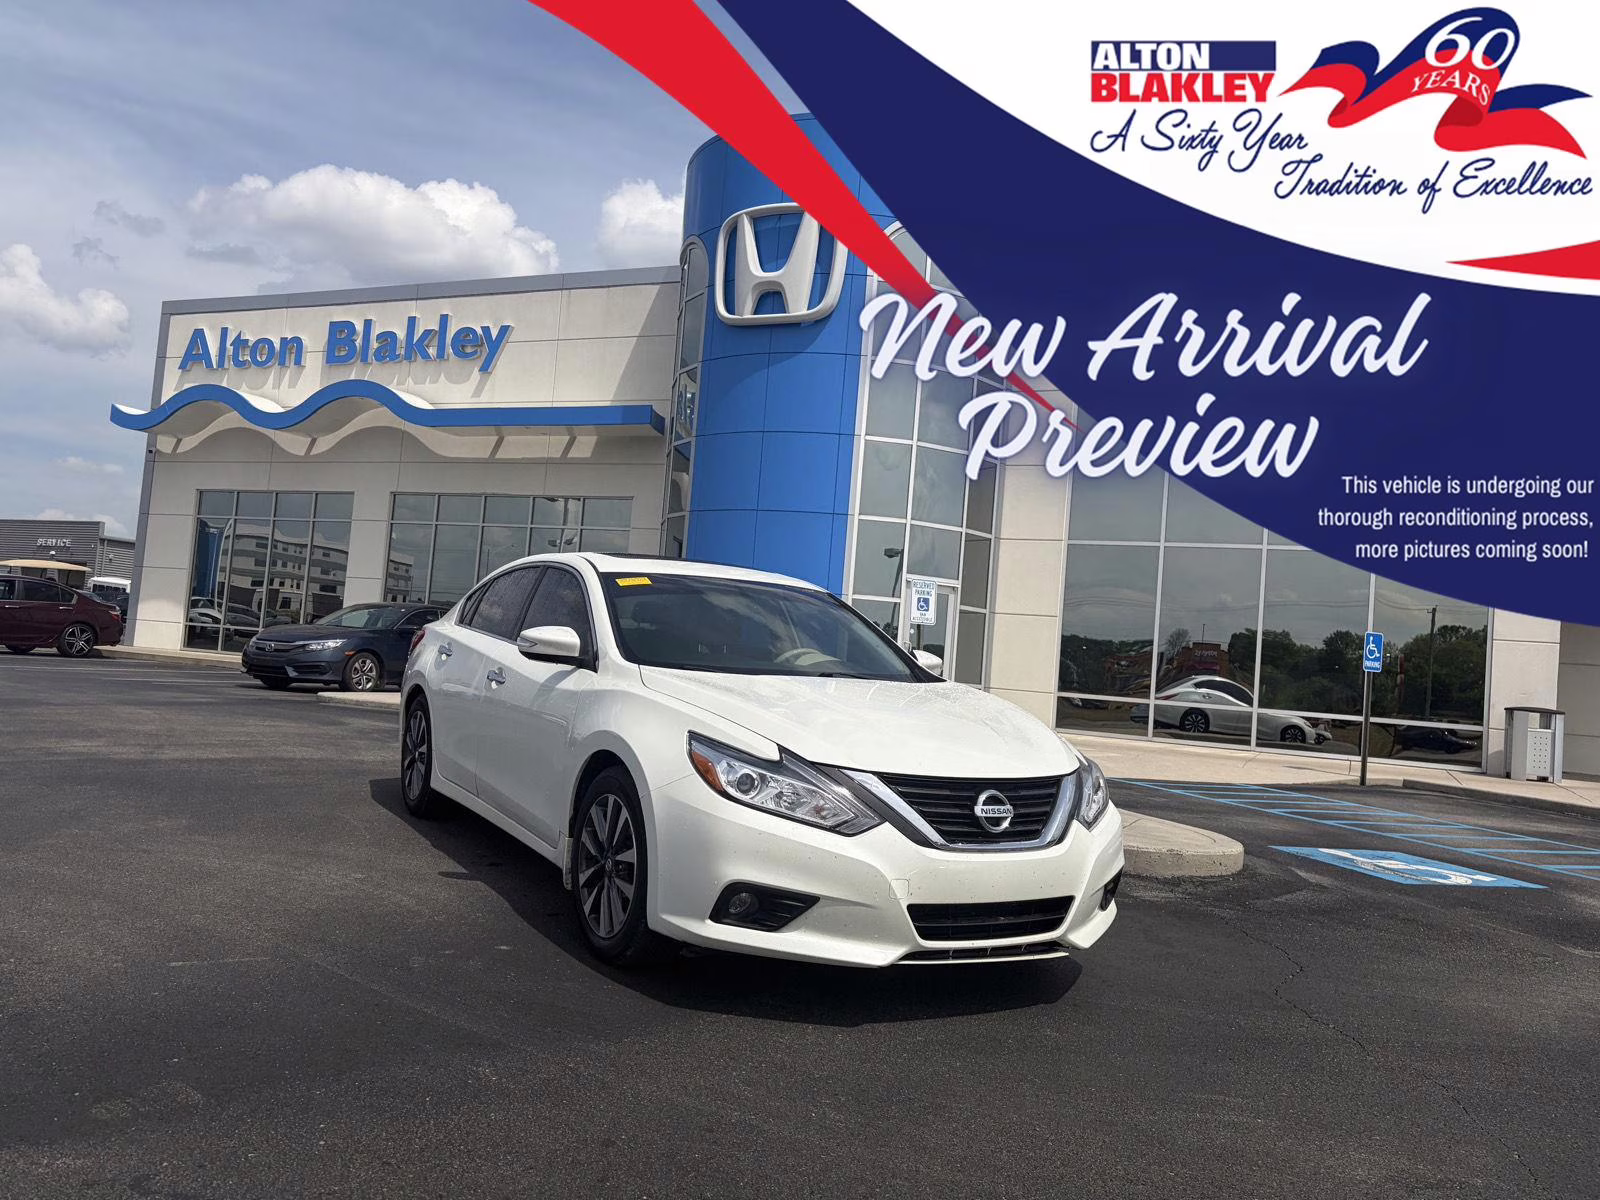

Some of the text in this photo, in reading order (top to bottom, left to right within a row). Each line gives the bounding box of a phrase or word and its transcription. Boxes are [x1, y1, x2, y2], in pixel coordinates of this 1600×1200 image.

[178, 312, 514, 374] Alton Blakley
[36, 538, 72, 547] SERVICE
[914, 589, 933, 597] PARKING
